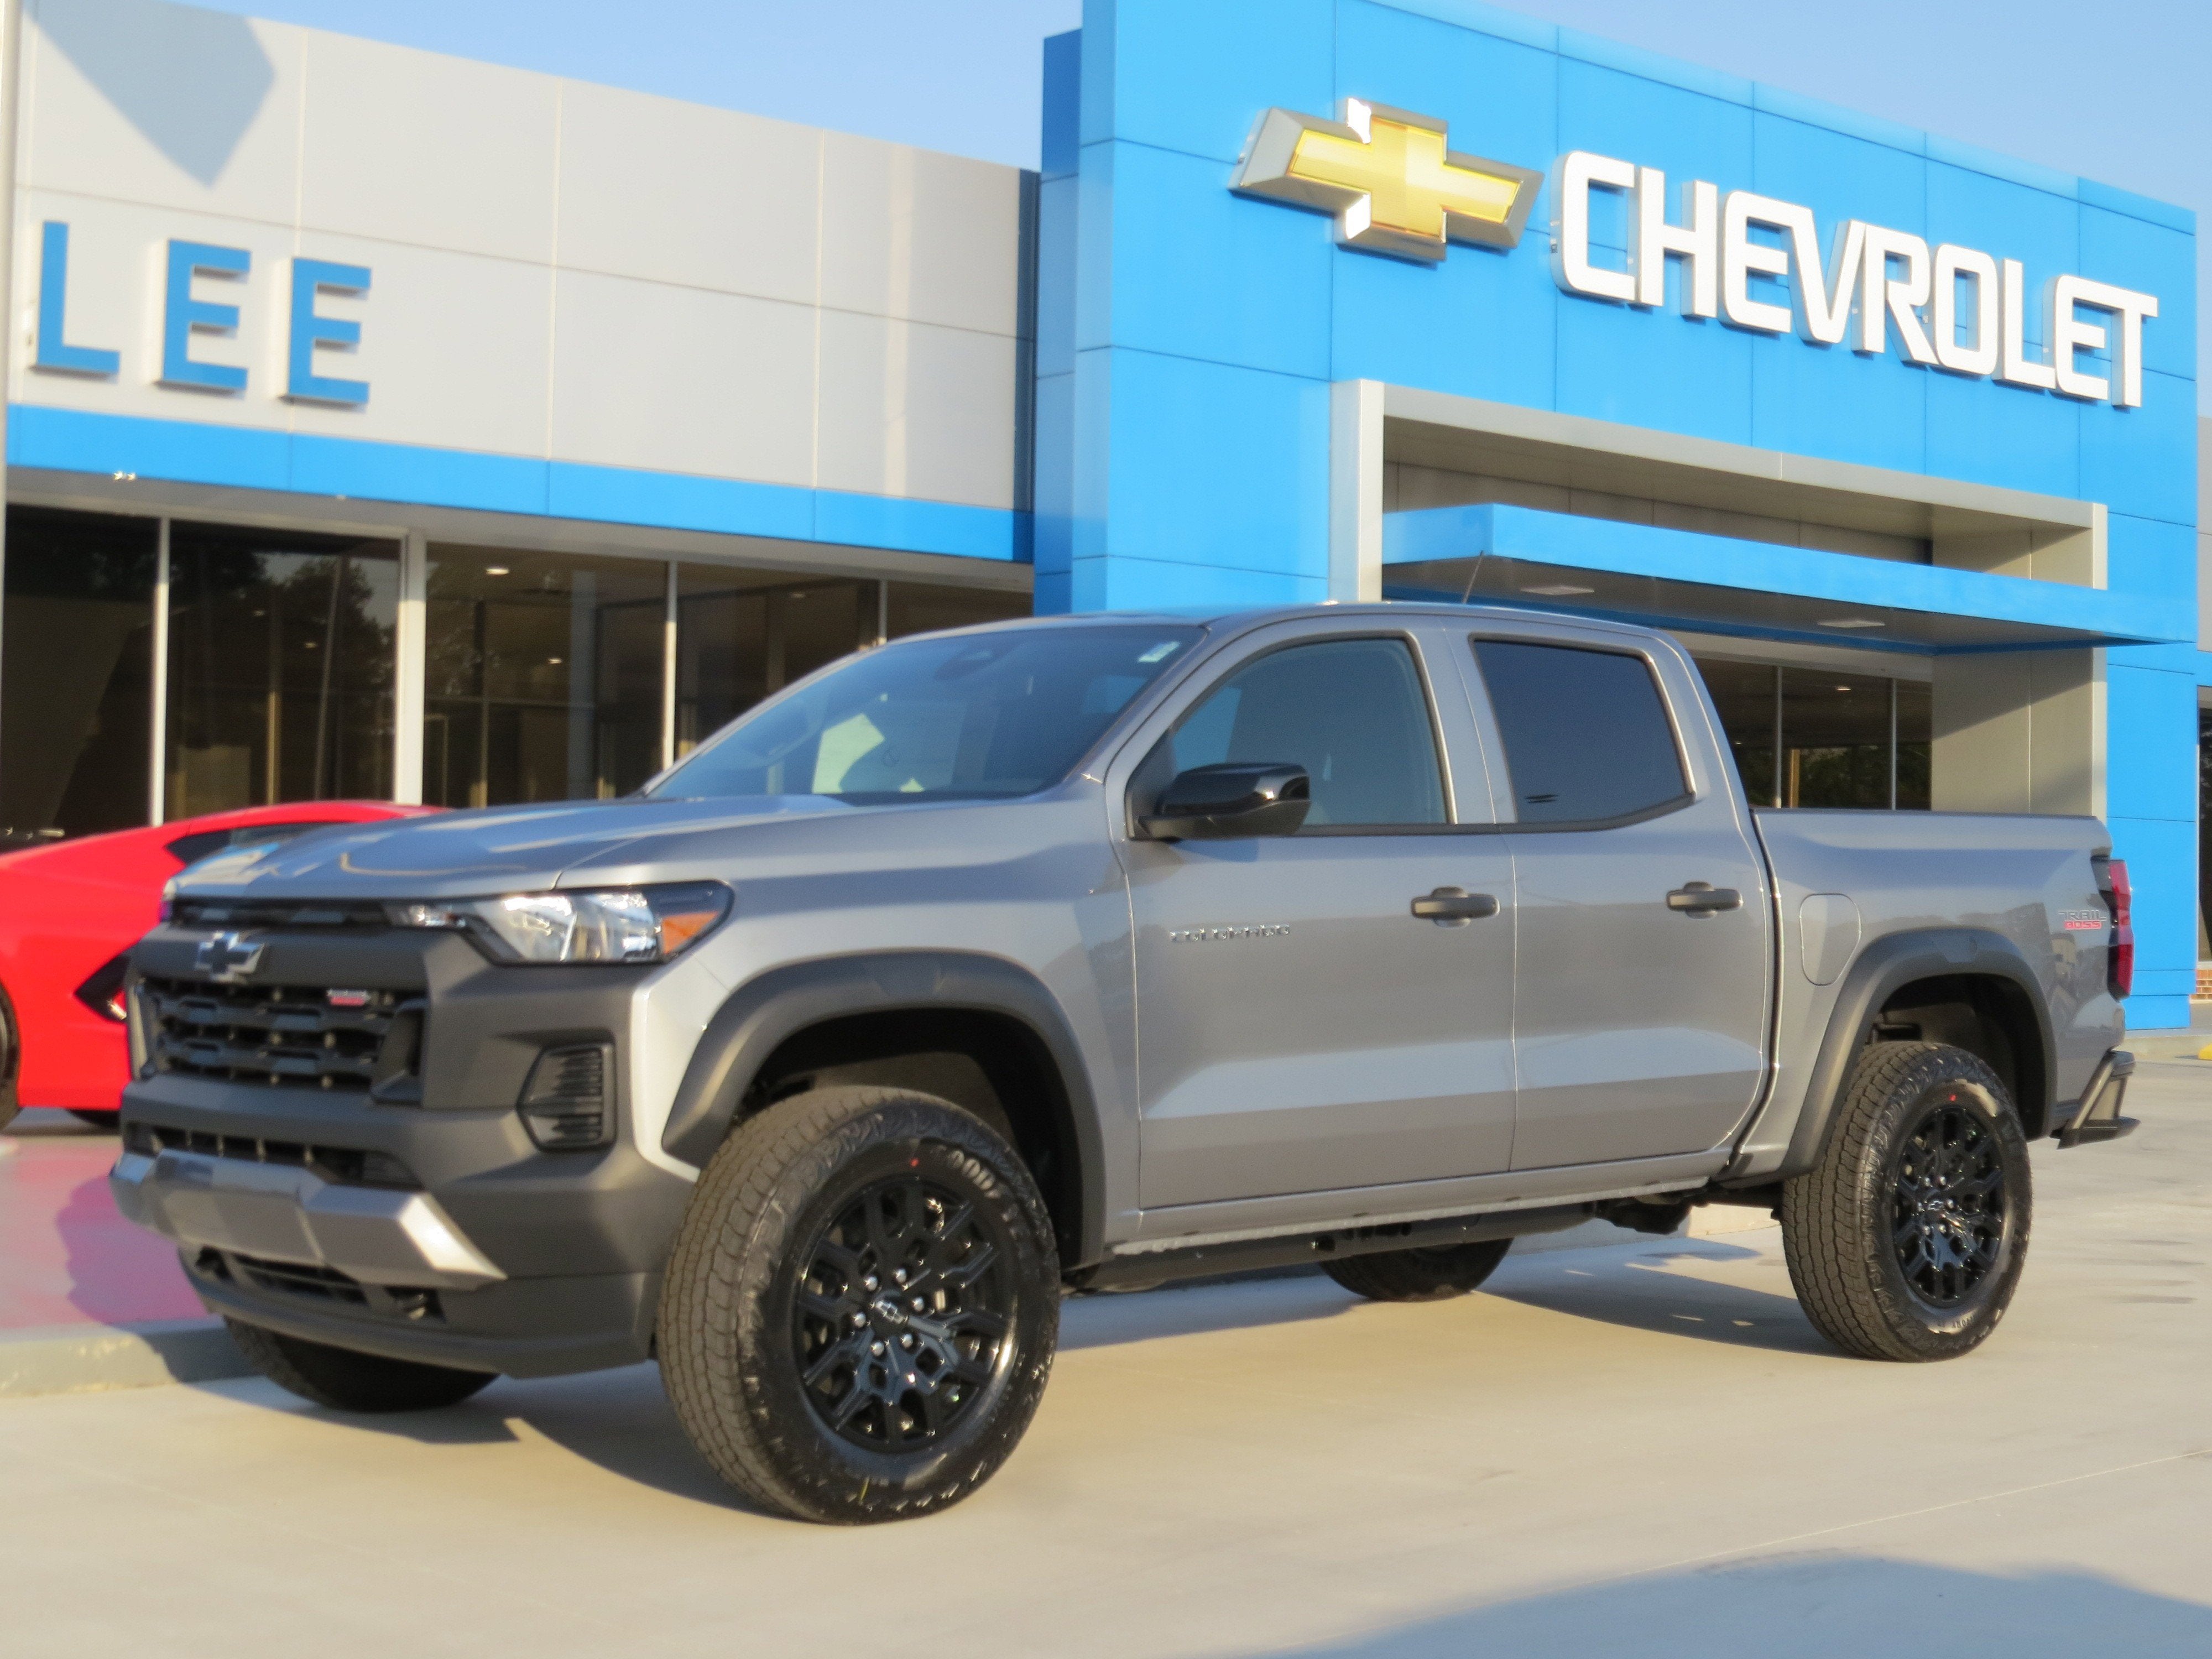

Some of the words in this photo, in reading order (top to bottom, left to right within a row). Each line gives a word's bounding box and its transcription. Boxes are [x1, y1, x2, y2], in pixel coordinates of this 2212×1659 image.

[37, 220, 372, 404] LEE
[1558, 150, 2159, 408] CHEVROLET
[2059, 910, 2107, 921] TRAIL
